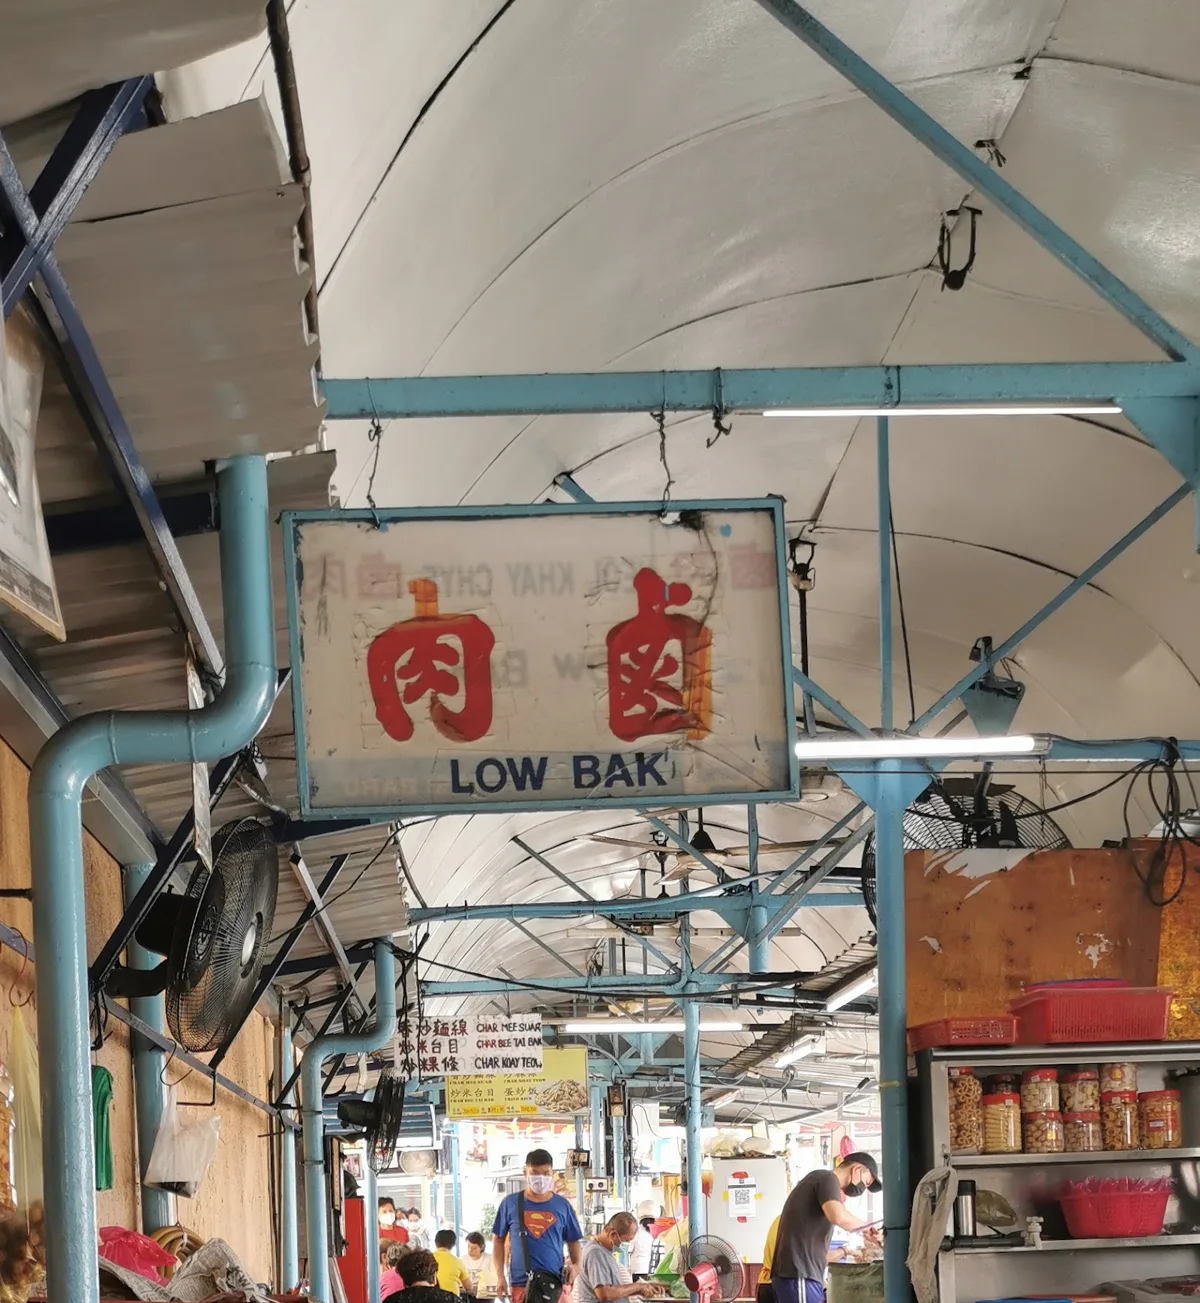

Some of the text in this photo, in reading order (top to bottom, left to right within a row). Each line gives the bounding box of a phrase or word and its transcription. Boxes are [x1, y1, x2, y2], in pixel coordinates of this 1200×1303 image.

[450, 752, 669, 795] LOW BAK
[476, 1023, 498, 1033] CHAR
[501, 1023, 518, 1033] MEE
[476, 1039, 497, 1049] CHAR
[498, 1038, 512, 1048] BEE
[474, 1056, 500, 1070] CHAR
[502, 1056, 520, 1069] KOAY
